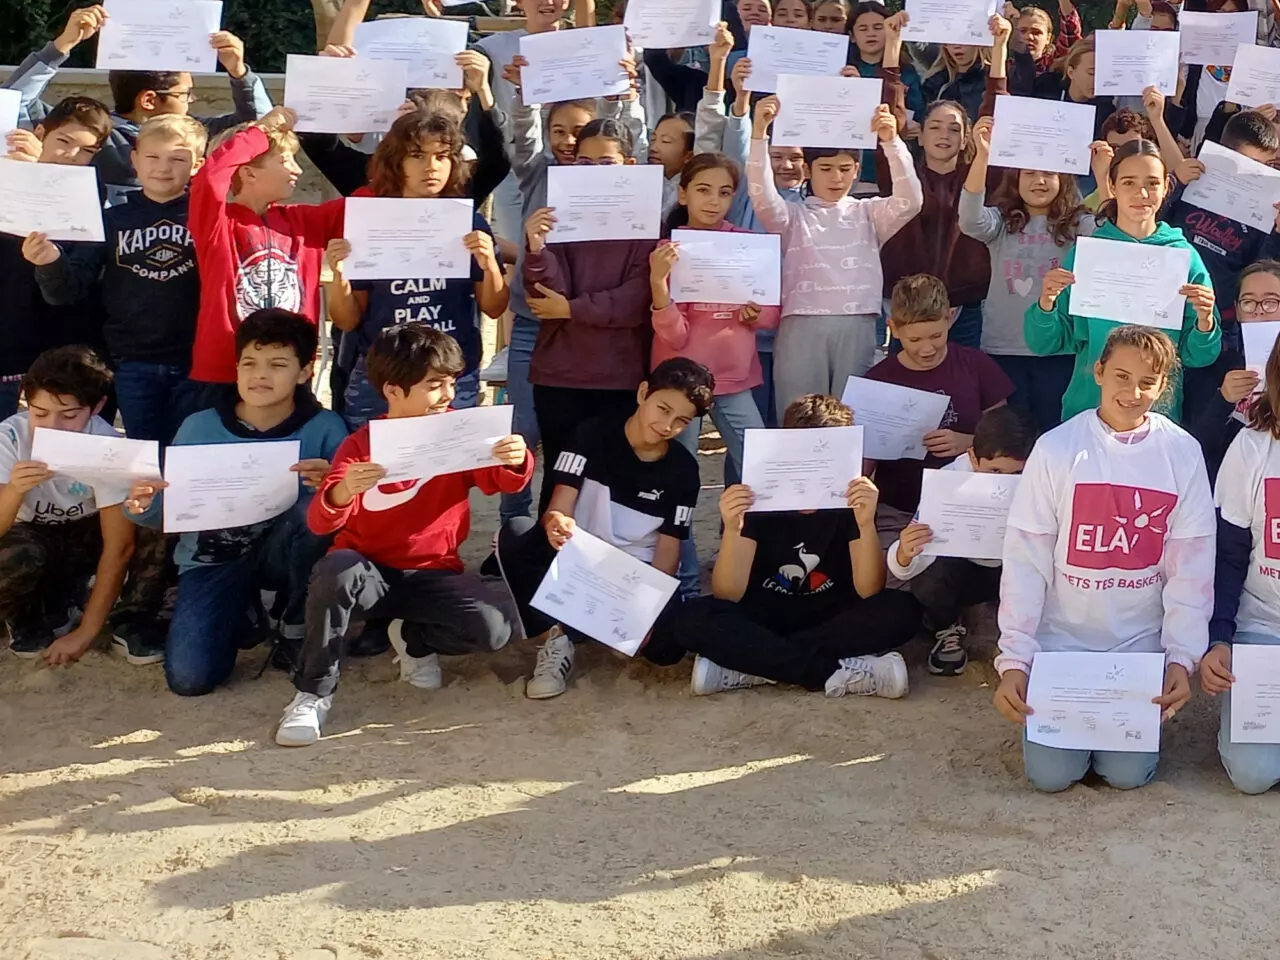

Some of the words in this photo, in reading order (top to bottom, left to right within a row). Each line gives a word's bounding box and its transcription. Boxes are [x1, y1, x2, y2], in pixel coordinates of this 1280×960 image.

[131, 258, 195, 280] COMPANY
[390, 278, 447, 295] CALM
[407, 295, 431, 305] AND
[394, 305, 442, 324] PLAY
[34, 500, 85, 517] Uber
[1076, 524, 1129, 554] ELA
